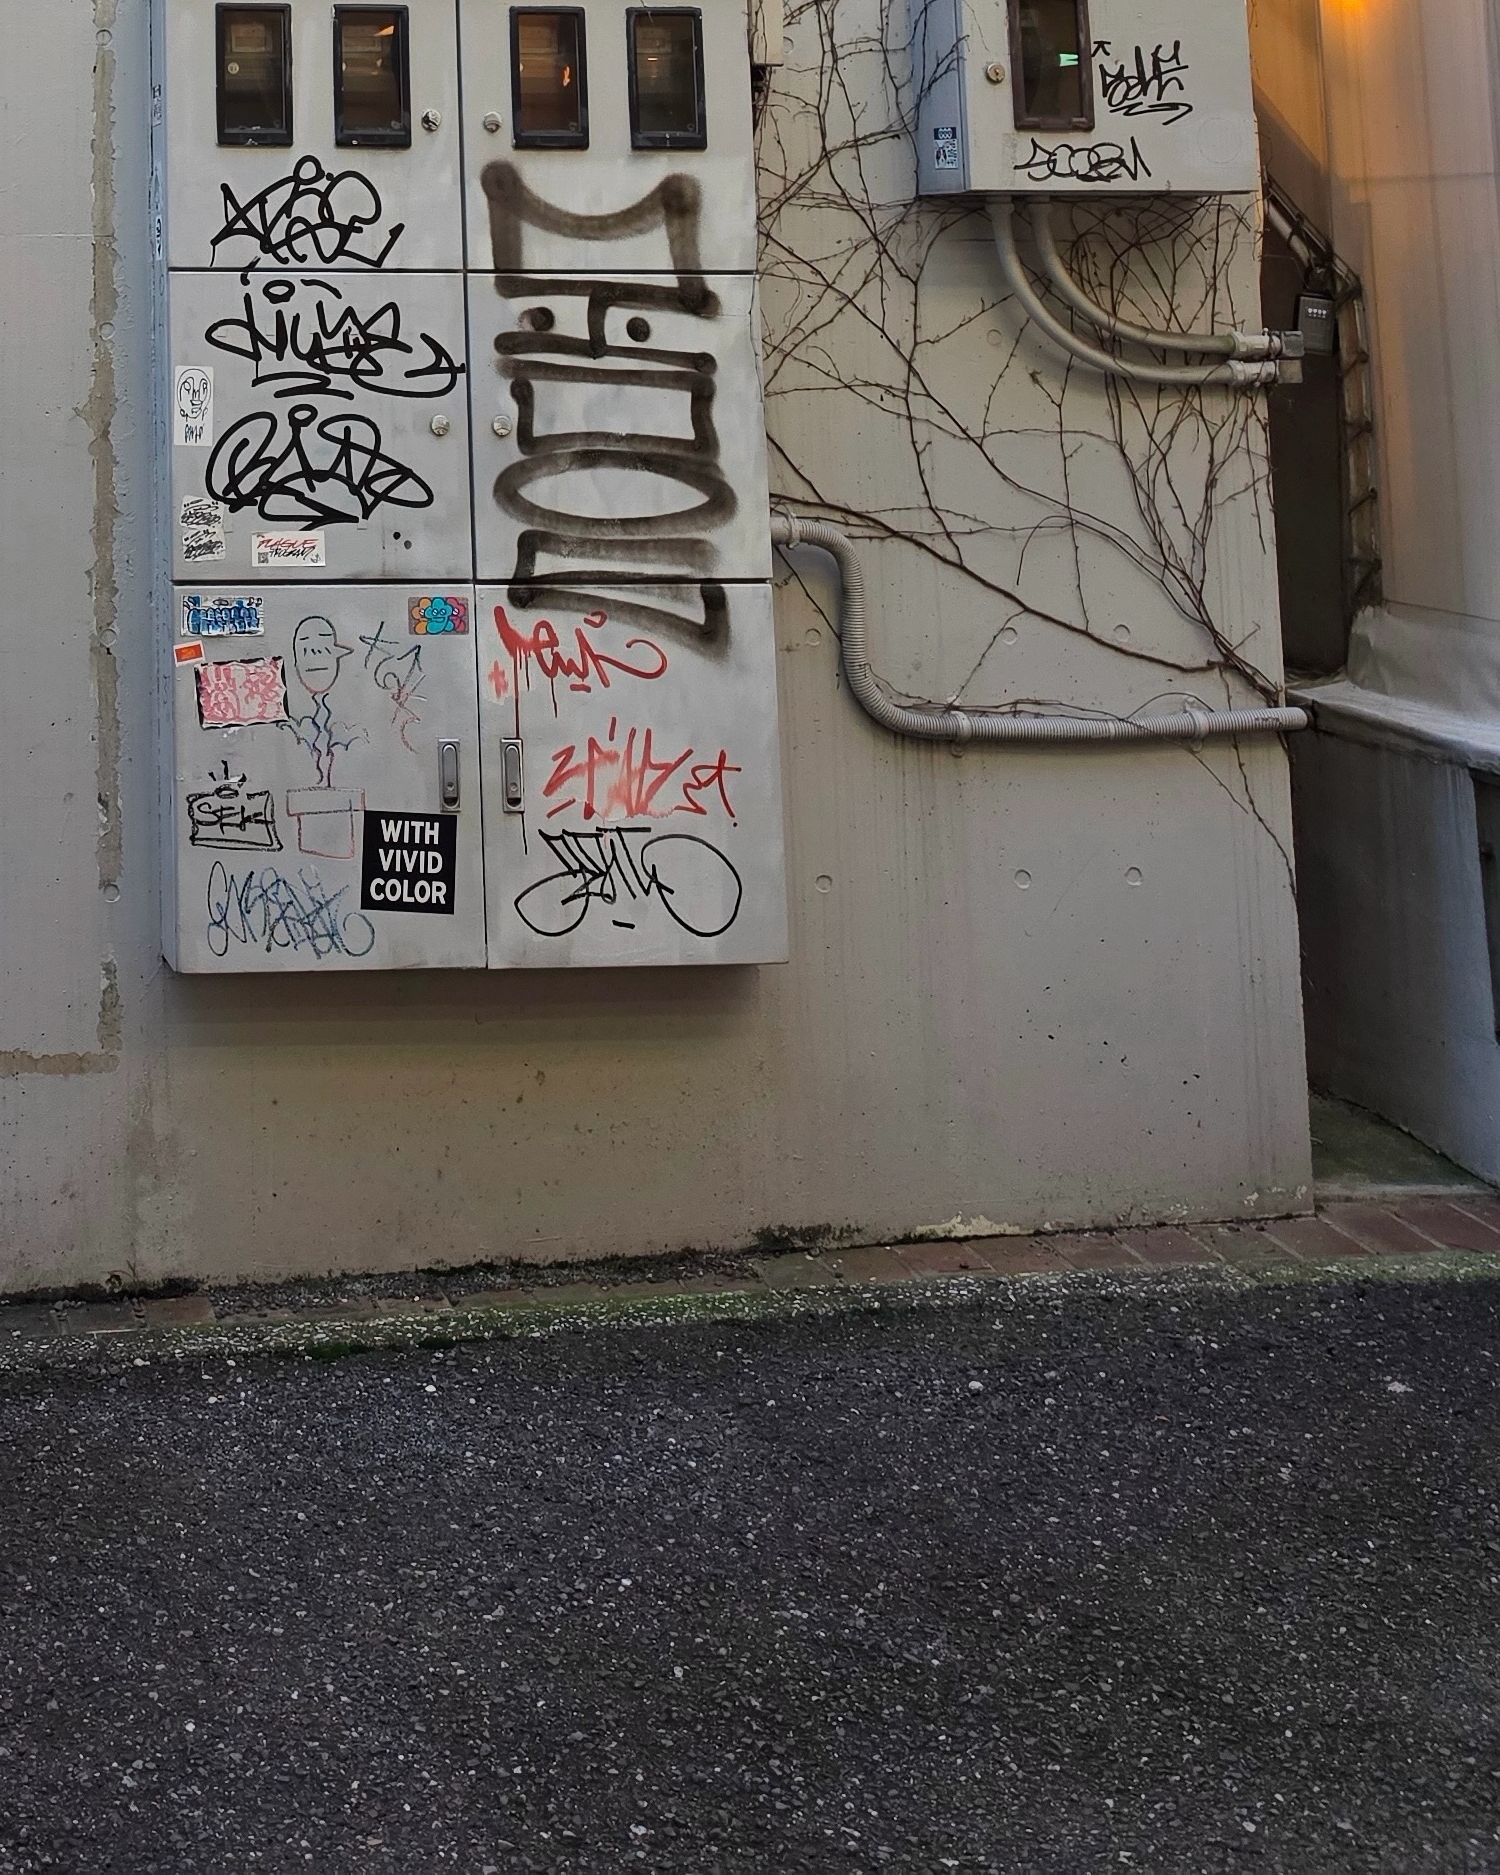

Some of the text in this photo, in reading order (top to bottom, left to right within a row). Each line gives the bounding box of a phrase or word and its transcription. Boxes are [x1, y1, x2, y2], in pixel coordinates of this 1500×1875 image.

[381, 819, 440, 845] WITH
[378, 848, 443, 874] VIVID
[369, 877, 447, 905] COLOR
